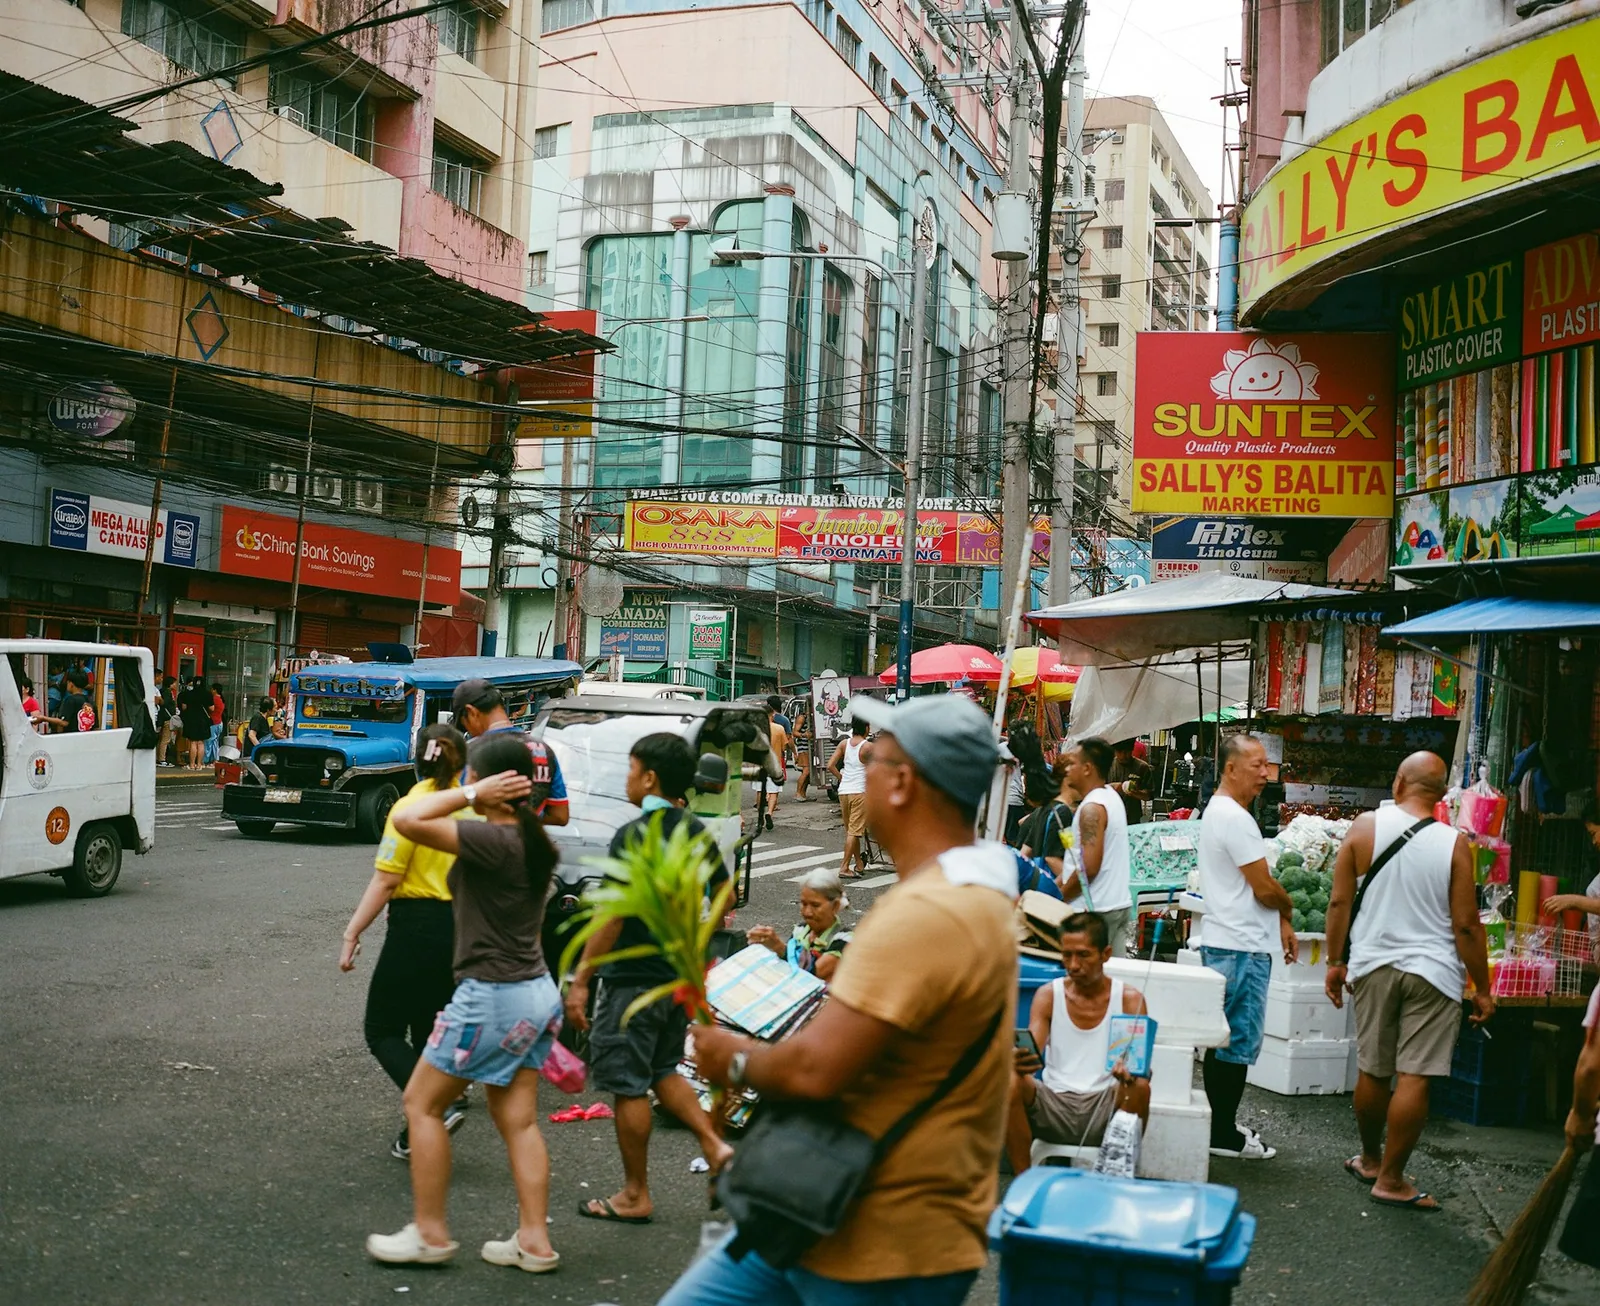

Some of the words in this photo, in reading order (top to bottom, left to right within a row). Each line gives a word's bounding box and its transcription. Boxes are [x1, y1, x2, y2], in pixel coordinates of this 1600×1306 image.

[1242, 113, 1428, 300] SALLY'S
[1528, 236, 1600, 311] ADV
[1401, 260, 1513, 350] SMART
[1406, 339, 1453, 381] PLASTIC
[1456, 327, 1503, 364] COVER
[1152, 402, 1378, 439] SUNTEX
[1185, 440, 1232, 458] Quality
[1234, 441, 1277, 456] Plastic
[1279, 442, 1337, 457] Products
[1139, 463, 1263, 494] SALLY'S
[1275, 464, 1387, 495] BALITA
[680, 489, 705, 502] YOU
[708, 491, 719, 503] &
[721, 492, 763, 505] COME
[766, 493, 807, 507] AGAIN
[811, 494, 885, 508] BARANGAY
[887, 497, 906, 509] 26
[917, 497, 953, 511] ZONE
[1202, 496, 1321, 513] MARKETING
[57, 510, 85, 524] Uratex
[91, 510, 123, 532] MEGA
[126, 517, 163, 538] ALLID
[635, 505, 775, 530] OSAKA
[100, 530, 147, 550] CANVAS
[635, 541, 659, 549] HIGH
[661, 542, 698, 551] QUALITY
[701, 543, 774, 553] FLOORMATTING
[302, 541, 328, 561] Bank
[332, 546, 375, 572] Savings
[802, 546, 943, 561] FLOORMATNG
[1196, 546, 1278, 560] Linoleum
[1267, 566, 1300, 575] Premium
[631, 593, 666, 606] NEW
[602, 620, 666, 629] COMMERCIAL
[693, 626, 722, 635] JUAN
[693, 635, 722, 643] LUNA
